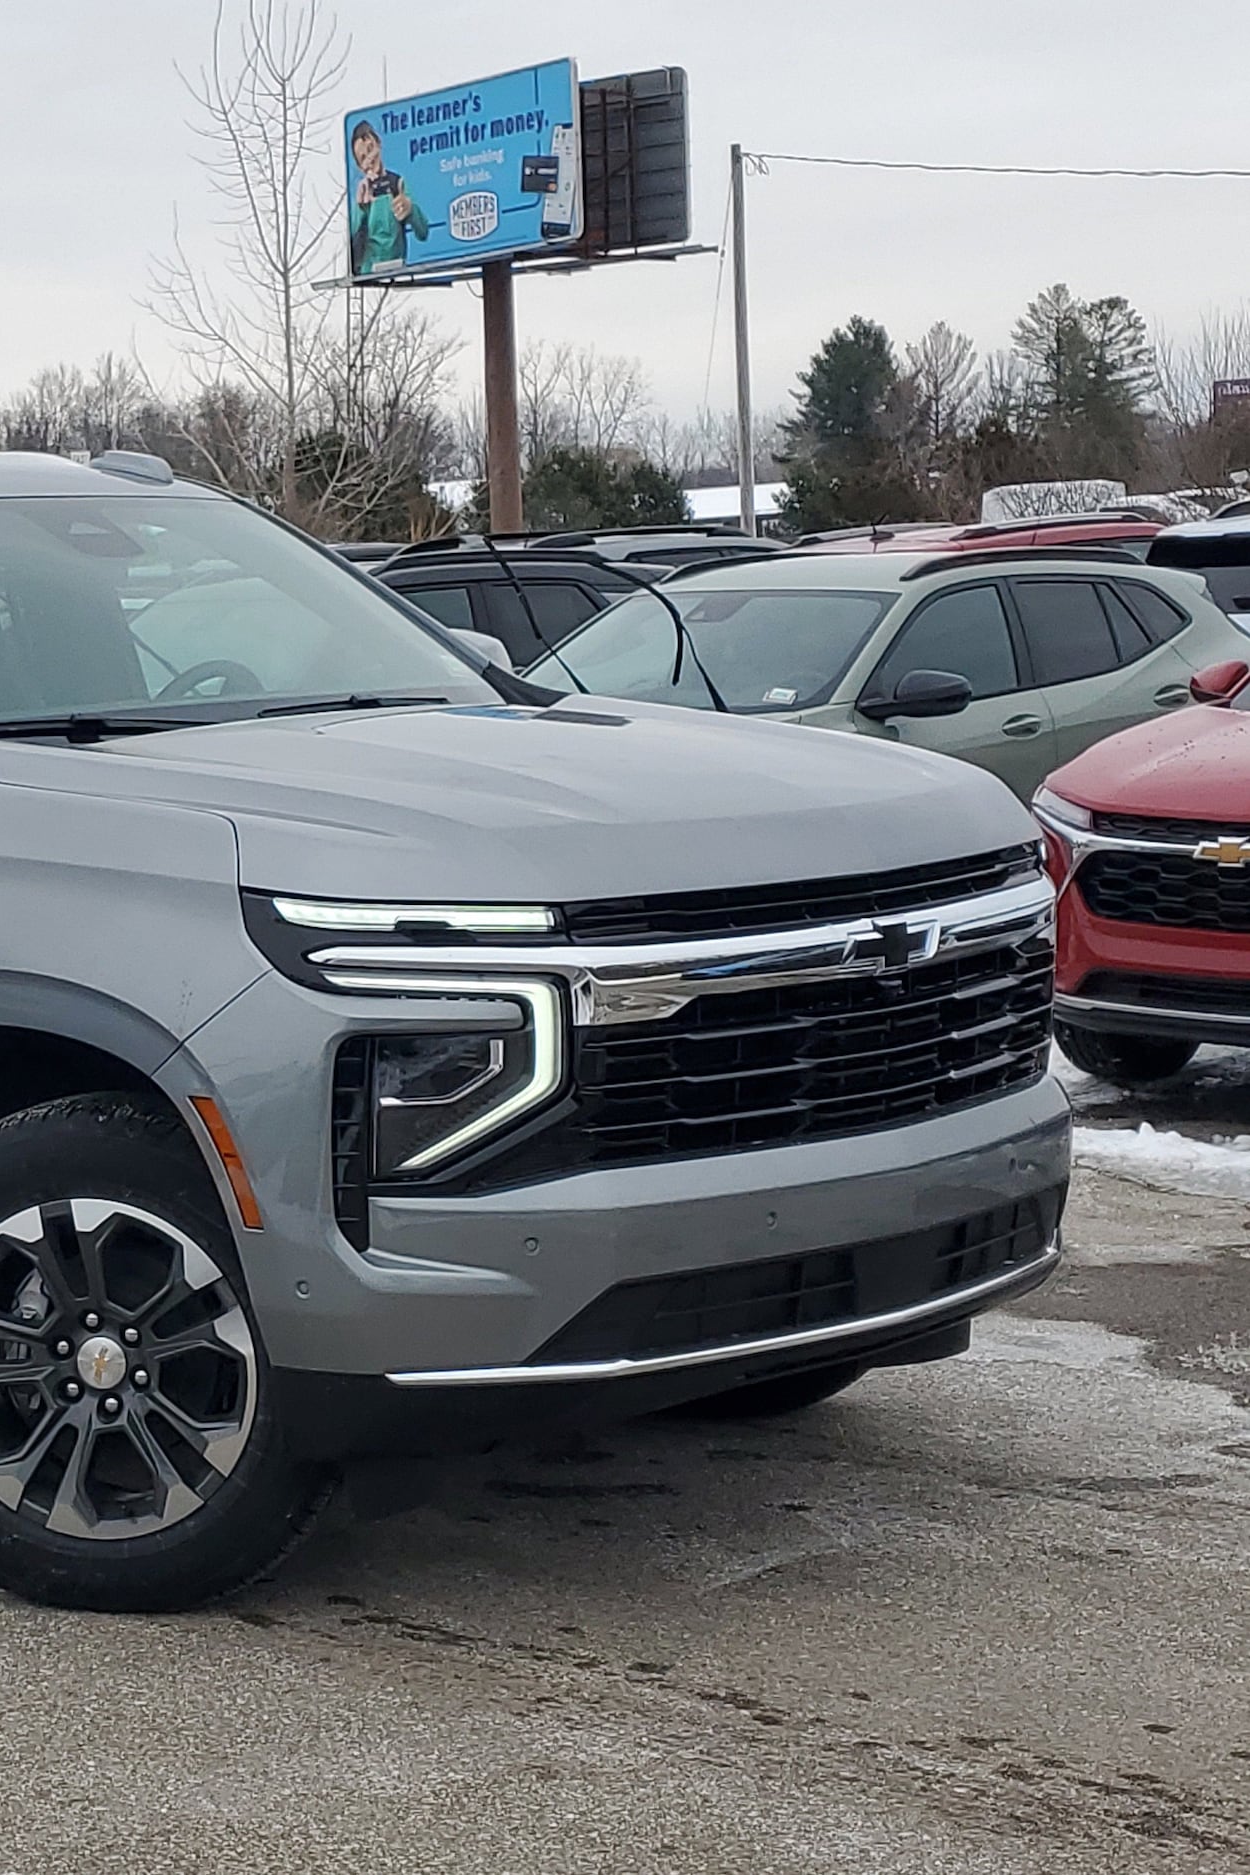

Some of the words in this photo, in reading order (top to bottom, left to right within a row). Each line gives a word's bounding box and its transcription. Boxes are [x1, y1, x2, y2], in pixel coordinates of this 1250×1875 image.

[382, 110, 408, 134] The
[411, 91, 481, 128] learner's
[410, 125, 460, 162] permit
[464, 121, 486, 144] for
[490, 109, 549, 139] money.
[440, 156, 462, 172] Safe
[453, 173, 466, 187] for
[452, 195, 495, 219] MEMBERS
[462, 217, 486, 238] FIRST
